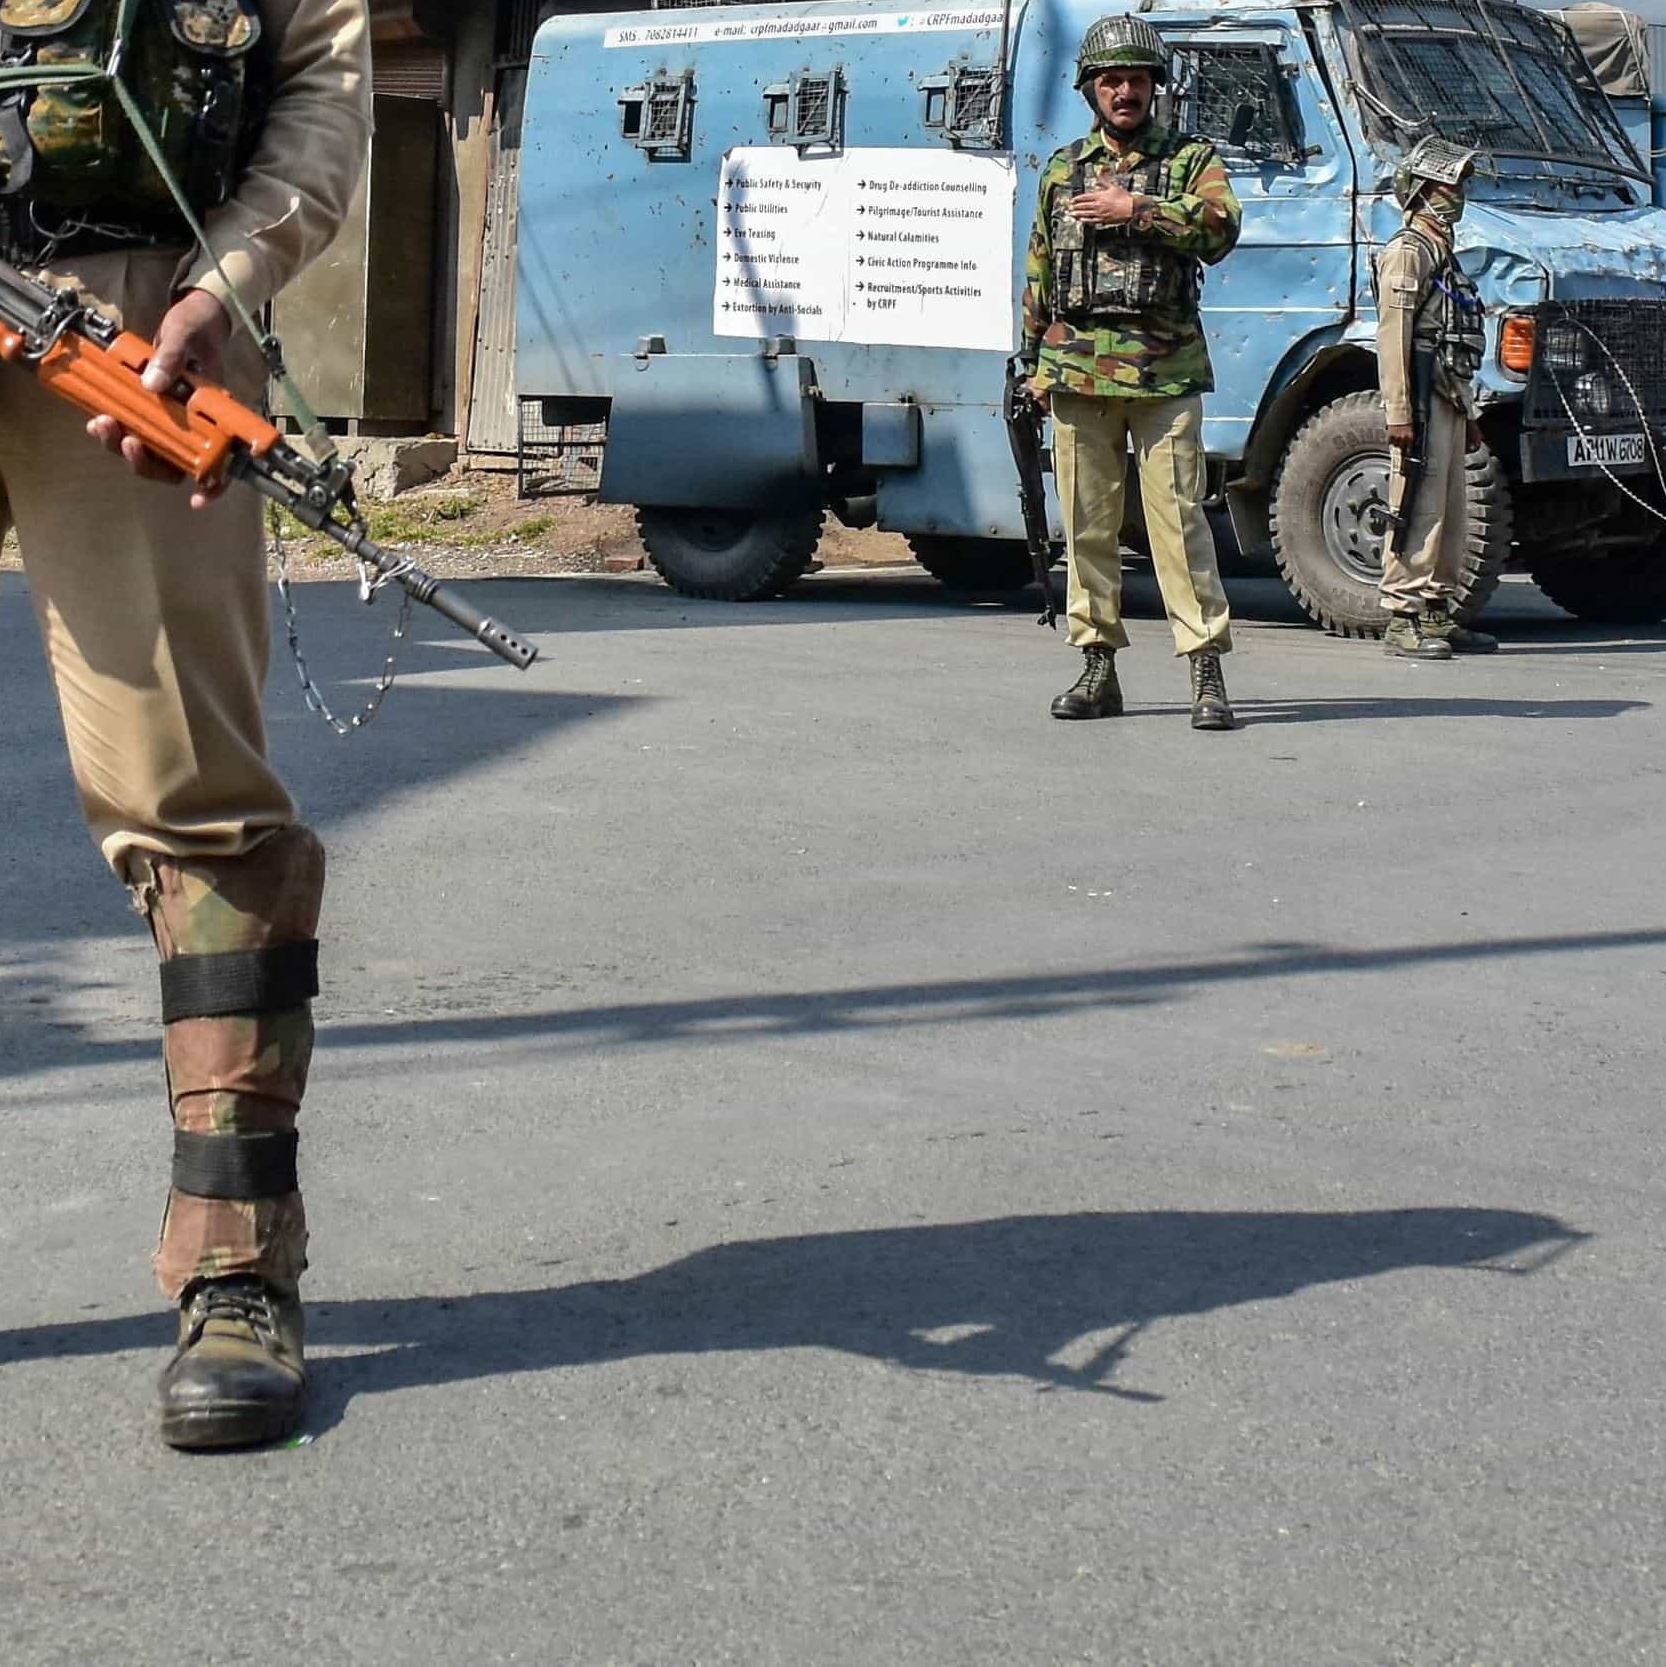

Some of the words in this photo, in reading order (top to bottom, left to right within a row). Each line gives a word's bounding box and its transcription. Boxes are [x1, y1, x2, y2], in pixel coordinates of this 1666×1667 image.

[736, 178, 758, 188] Public
[759, 179, 783, 191] Safety
[784, 180, 790, 189] &
[791, 179, 822, 191] Security
[869, 180, 888, 193] Drug
[889, 181, 939, 191] De-addiction
[941, 181, 987, 195] Counselling
[735, 204, 757, 213] Public
[941, 207, 984, 219] Assistance
[734, 228, 746, 238] Eve
[748, 228, 776, 240] Teasing
[868, 231, 897, 242] Natural
[898, 232, 940, 243] Calamities
[734, 253, 767, 263] Domestic
[868, 256, 885, 267] Civic
[887, 257, 911, 268] Action
[913, 258, 959, 271] Programme
[961, 259, 977, 271] Info
[734, 277, 761, 288] Medical
[763, 279, 801, 289] Assistance
[867, 282, 943, 295] Recruitment/Sports
[944, 285, 982, 297] Activities
[733, 301, 767, 312] Extortion
[768, 303, 778, 315] by
[779, 304, 823, 315] Anti-Socials
[867, 298, 877, 310] by
[878, 299, 897, 310] CRPF
